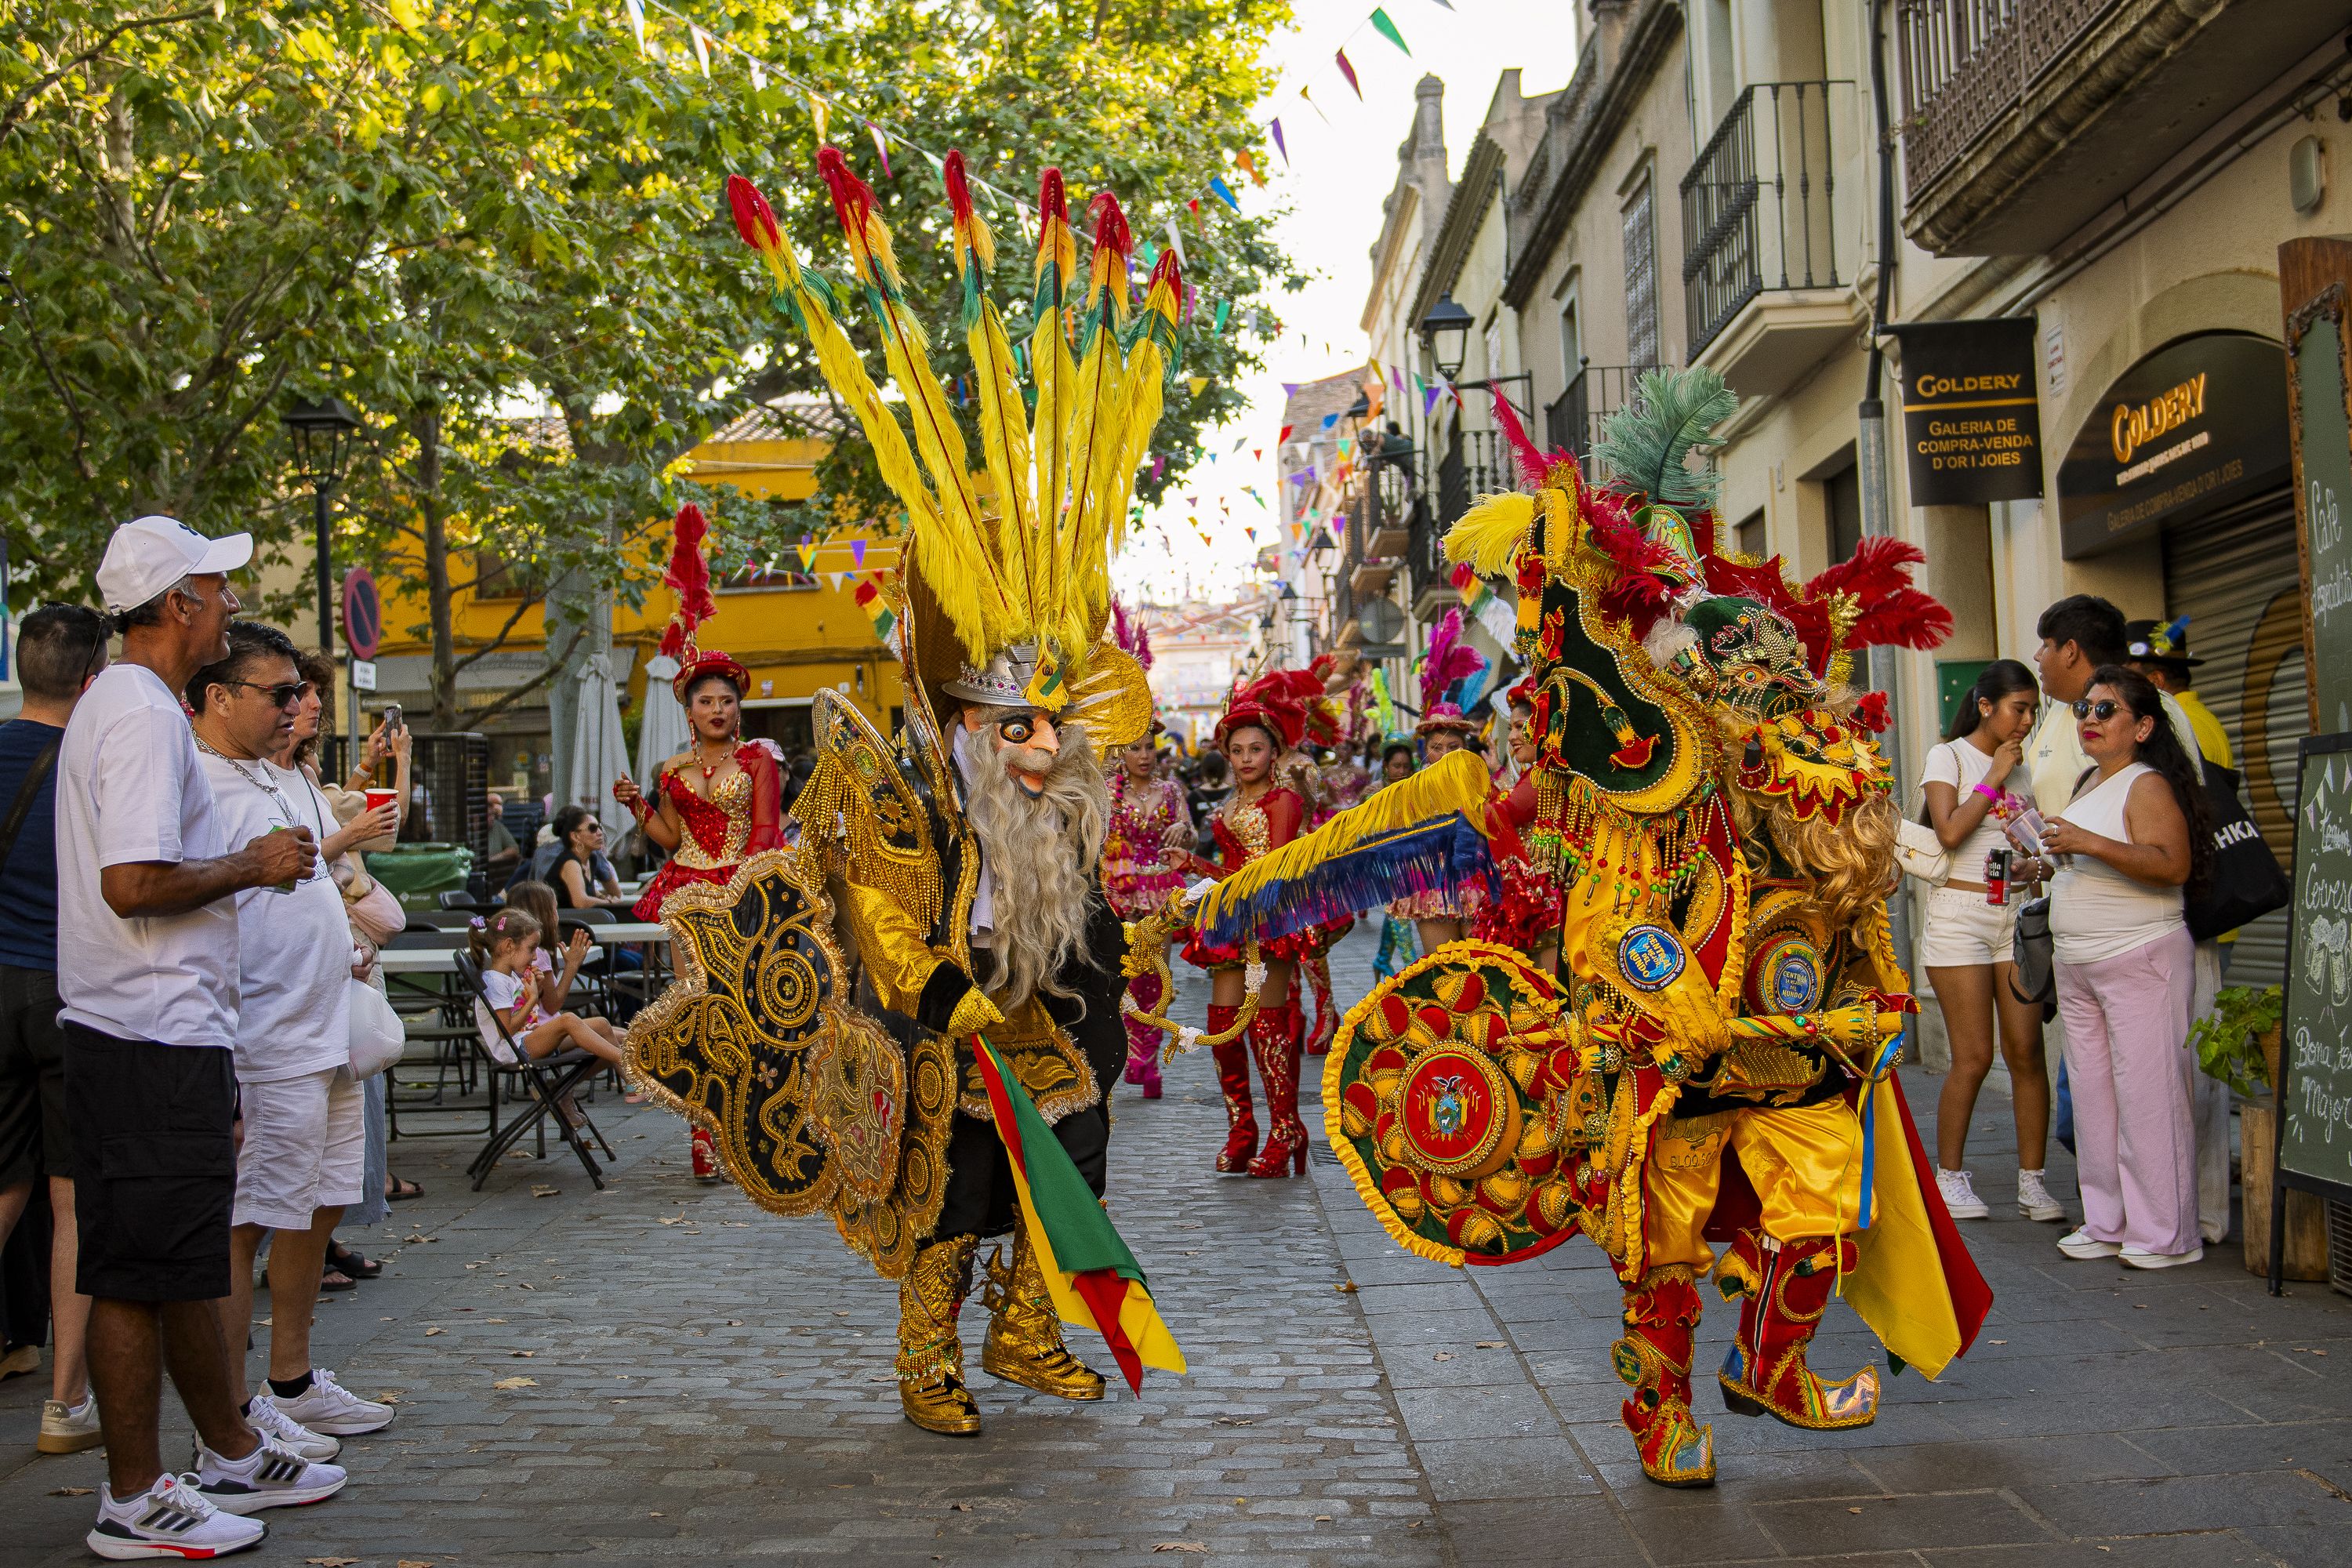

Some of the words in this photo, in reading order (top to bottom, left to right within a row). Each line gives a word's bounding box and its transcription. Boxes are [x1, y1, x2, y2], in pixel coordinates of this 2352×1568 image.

[1916, 374, 2020, 397] GOLDERY
[2111, 372, 2207, 463] GOLDERY
[1929, 420, 1994, 437] GALERIA
[1997, 419, 2017, 432] DE
[1918, 434, 2034, 454] COMPRA-VENDA
[1971, 455, 1976, 467] I
[1979, 452, 2021, 468] JOIES
[1628, 949, 1650, 978] MUNDO
[1783, 989, 1802, 1000] MUNDO
